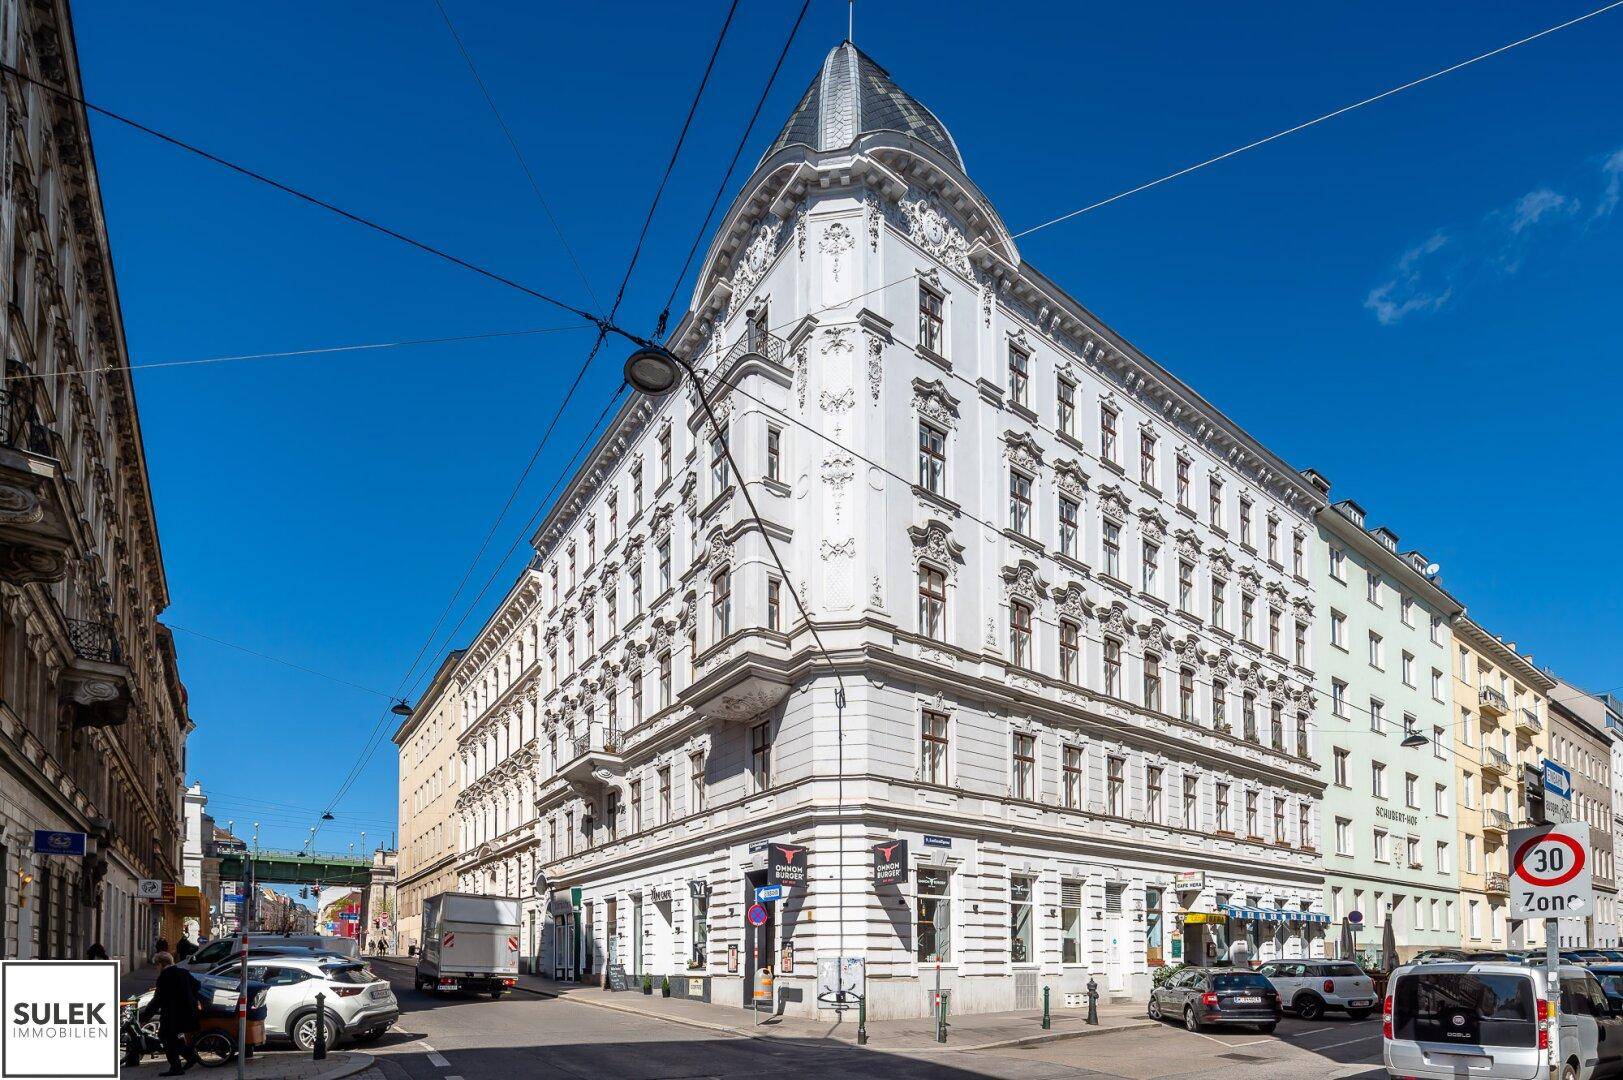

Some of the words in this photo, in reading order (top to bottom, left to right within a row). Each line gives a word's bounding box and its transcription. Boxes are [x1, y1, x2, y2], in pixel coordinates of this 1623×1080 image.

[1533, 847, 1564, 873] 30
[775, 864, 803, 873] OMNOM
[876, 862, 900, 872] OMNOM
[775, 871, 804, 880] BURGER
